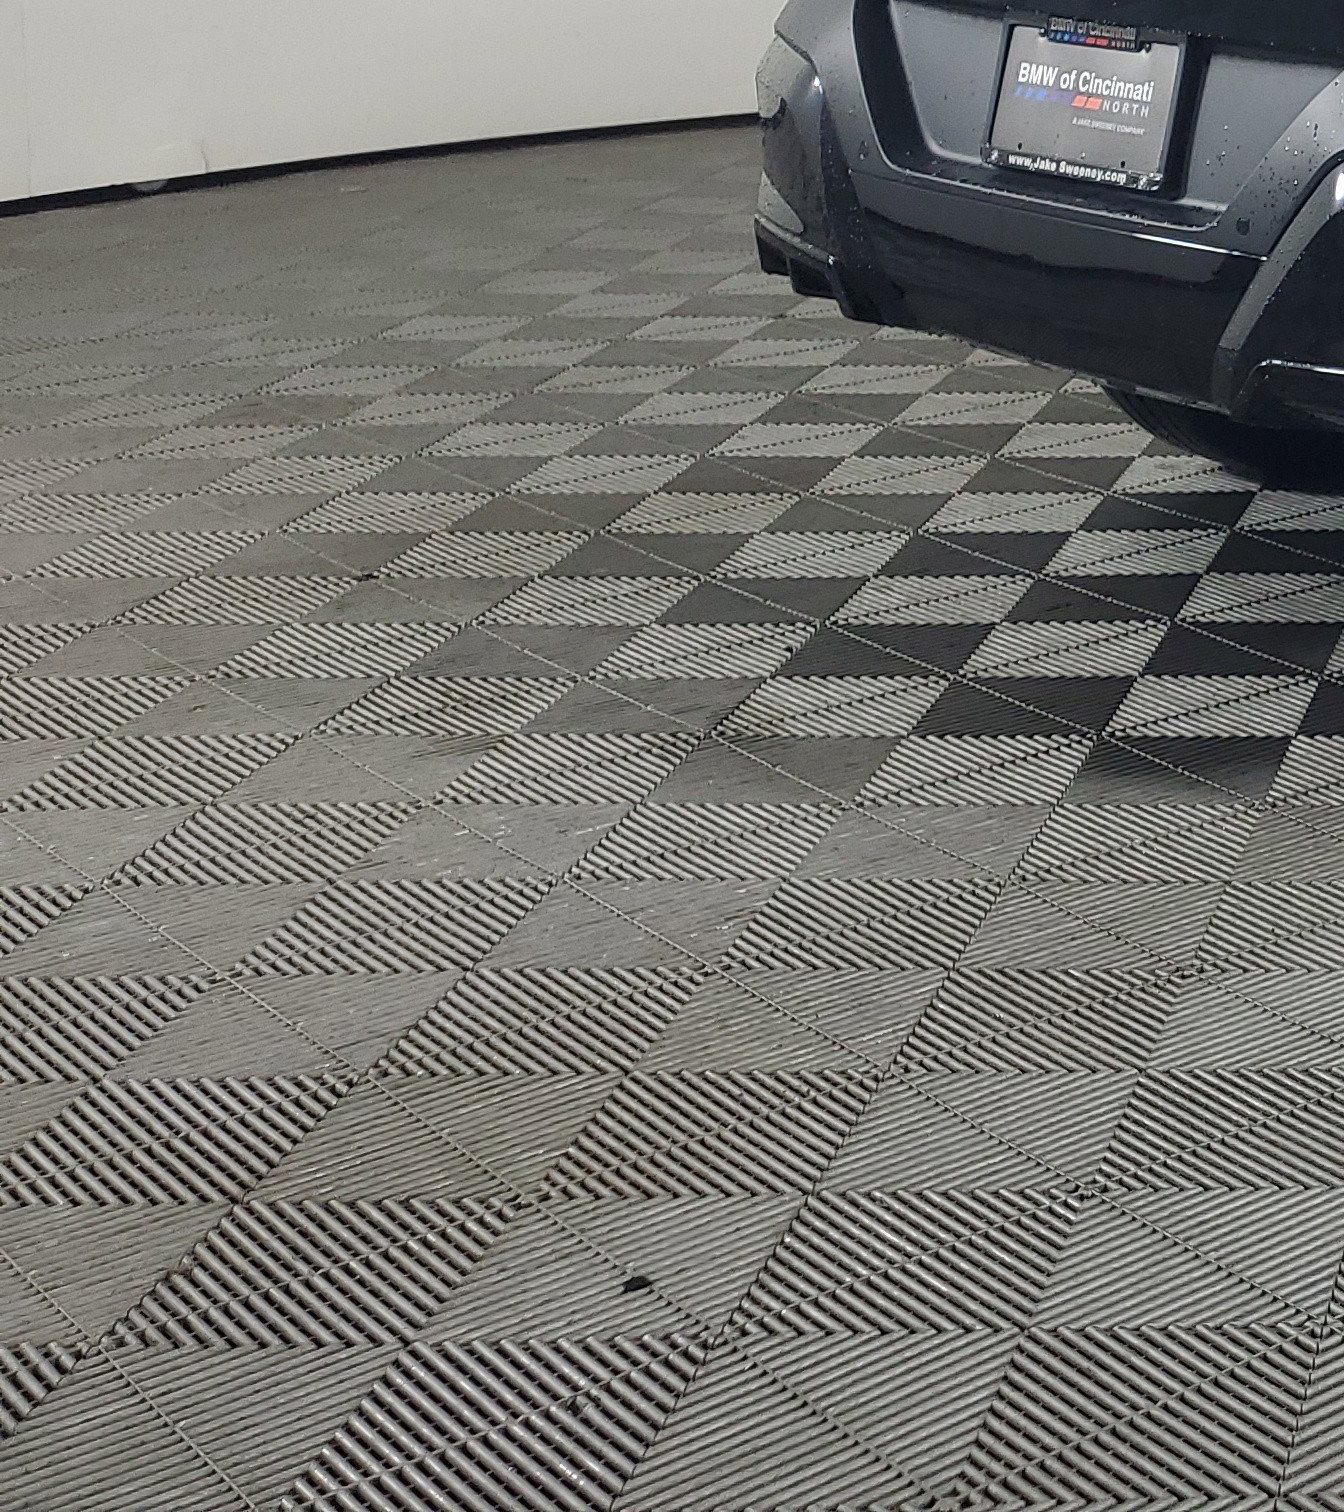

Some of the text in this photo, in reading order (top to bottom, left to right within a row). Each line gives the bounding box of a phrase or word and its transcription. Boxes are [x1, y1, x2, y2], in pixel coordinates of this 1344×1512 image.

[1018, 62, 1155, 102] BMW of Cincinnati
[1102, 99, 1149, 118] NORTH
